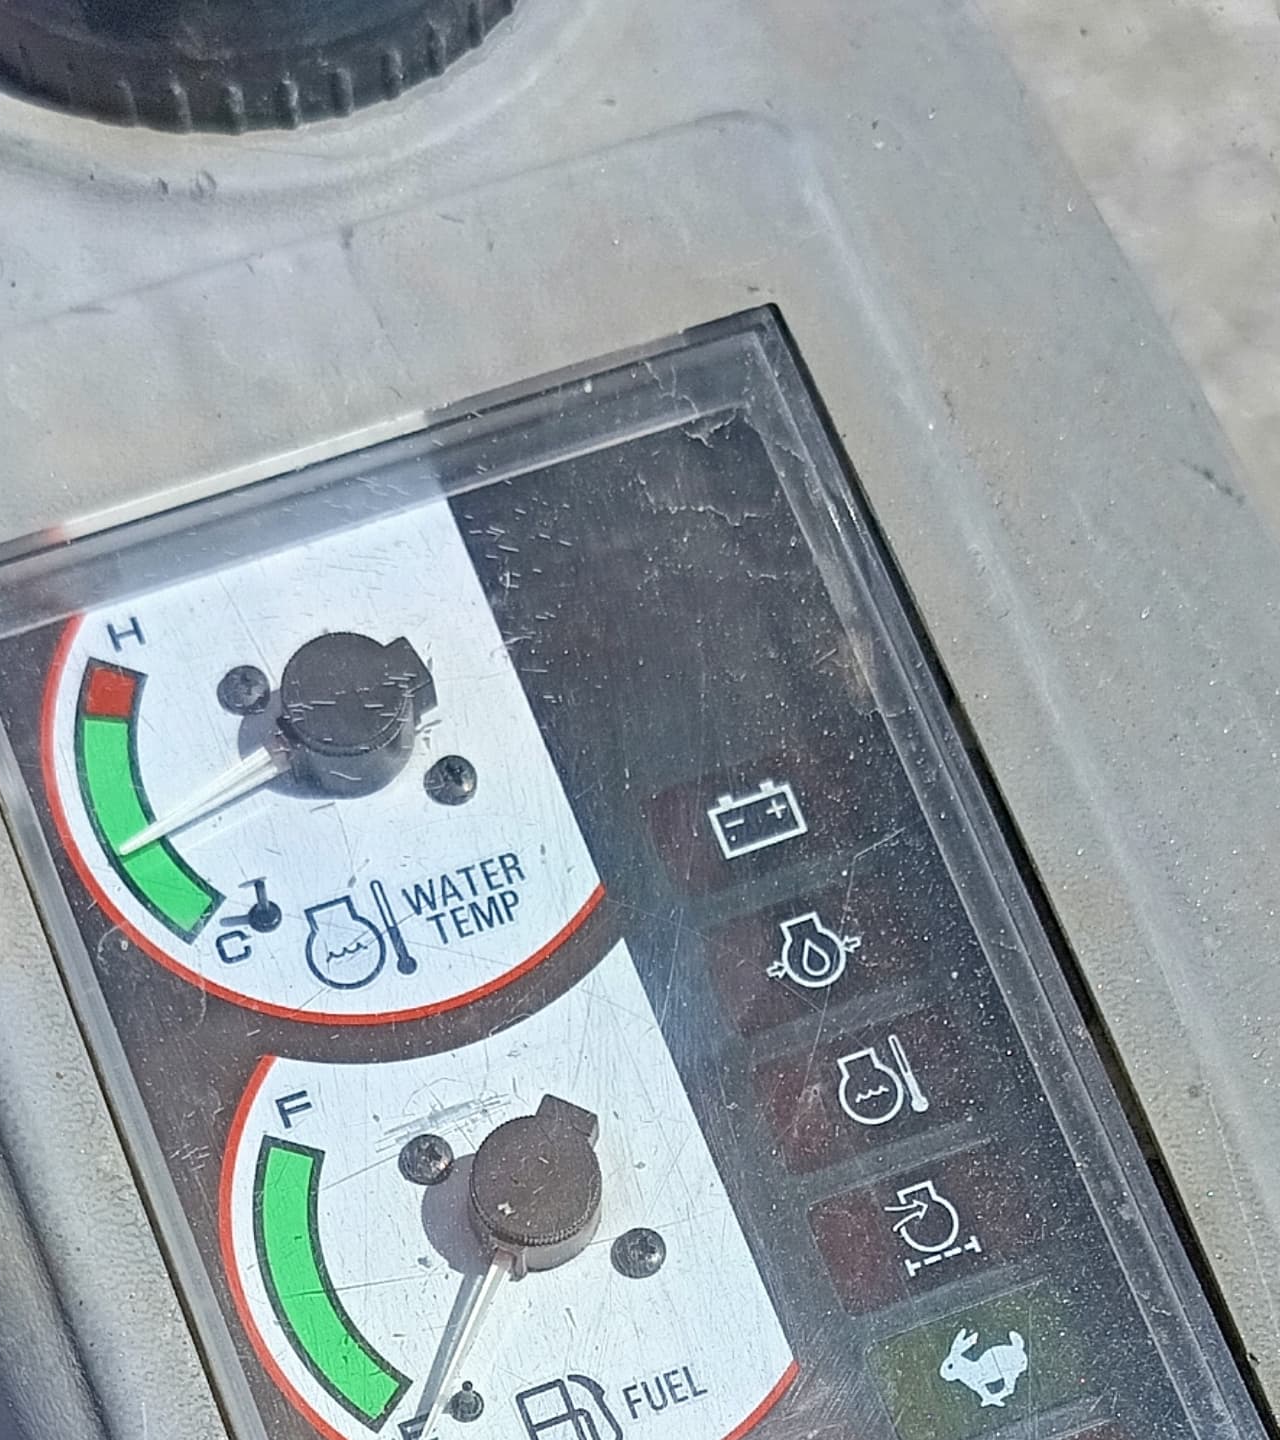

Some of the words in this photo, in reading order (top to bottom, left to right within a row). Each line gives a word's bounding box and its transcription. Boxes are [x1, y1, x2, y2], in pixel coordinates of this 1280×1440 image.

[106, 616, 147, 652] H
[401, 851, 527, 914] WATER
[426, 889, 522, 946] TEMP
[214, 929, 254, 965] C
[274, 1089, 313, 1130] F
[623, 1364, 708, 1421] FUEL
